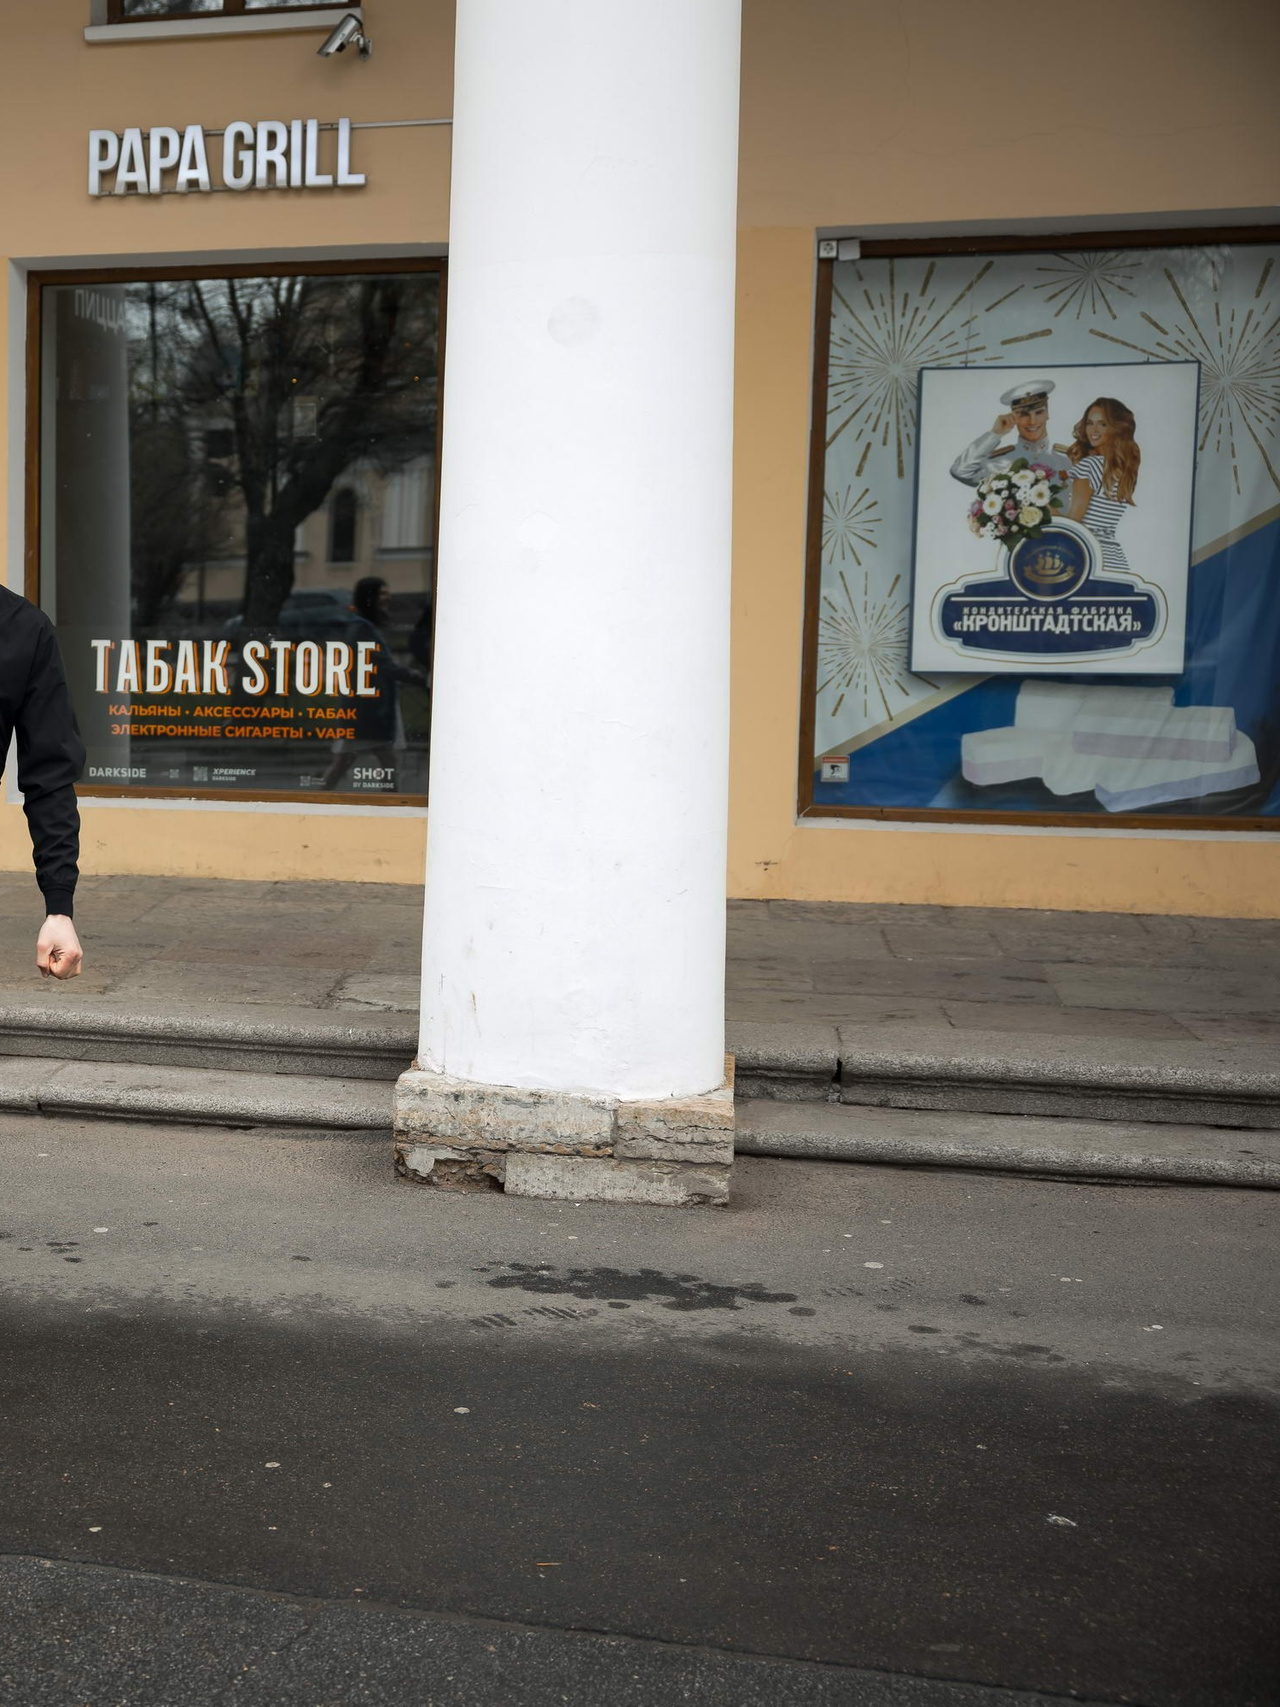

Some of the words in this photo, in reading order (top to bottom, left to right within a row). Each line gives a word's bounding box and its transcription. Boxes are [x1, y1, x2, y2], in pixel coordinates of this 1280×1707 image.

[88, 124, 212, 196] PAPA
[222, 117, 367, 190] GRILL
[962, 607, 1063, 616] КОНДИТЕРСКАЯ
[1071, 607, 1133, 615] ФАБРИКА
[953, 615, 1141, 634] «КРОНШТАДТСКАЯ»
[91, 639, 231, 695] ТАБАК
[242, 641, 381, 697] STORE
[109, 705, 181, 717] КАЛЬЯНЫ
[193, 706, 294, 719] АКСЕССУАРЫ
[306, 708, 357, 720] ТАБАК
[110, 724, 222, 737] ЭЛЕКТРОННЫЕ
[224, 726, 303, 739] СИГАРЕТЫ
[315, 727, 356, 740] VAPE
[89, 767, 147, 778] DARKSIDE
[353, 767, 395, 780] SHOT
